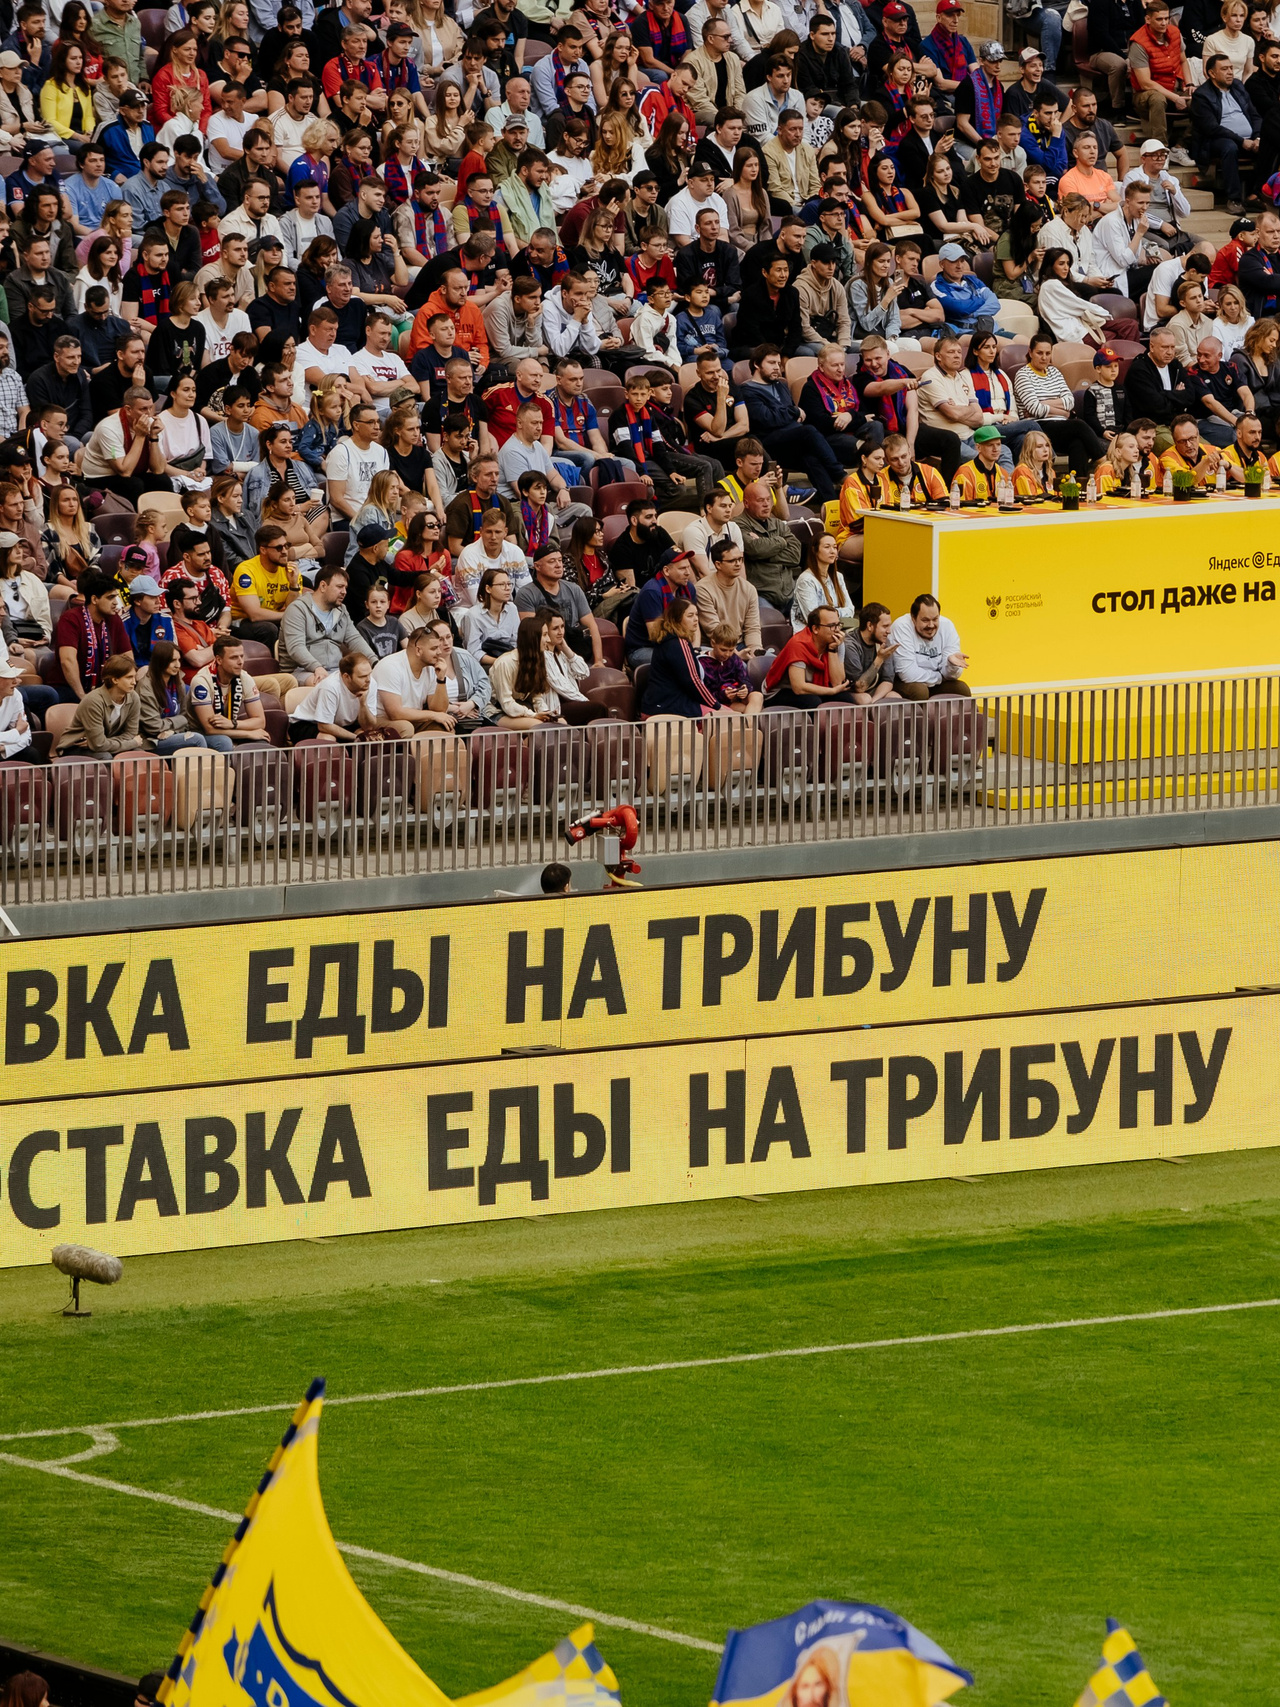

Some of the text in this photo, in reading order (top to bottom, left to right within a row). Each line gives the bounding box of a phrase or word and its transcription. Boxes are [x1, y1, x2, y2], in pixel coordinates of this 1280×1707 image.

[1208, 556, 1251, 571] Яндекс
[1004, 600, 1044, 610] ФУТБОЛЬНЫЙ
[1005, 593, 1042, 602] РОССИЙСКИЙ
[1091, 588, 1155, 614] стол
[1161, 581, 1237, 616] даже
[1244, 579, 1276, 603] на
[1004, 609, 1021, 618] СОЮЗ
[246, 933, 451, 1060] ЕДЫ
[505, 923, 627, 1024] НА
[647, 887, 1048, 1012] ТРИБУНУ
[0, 1026, 1234, 1231] СТАВКА ЕДЫ НА ТРИБУНУ
